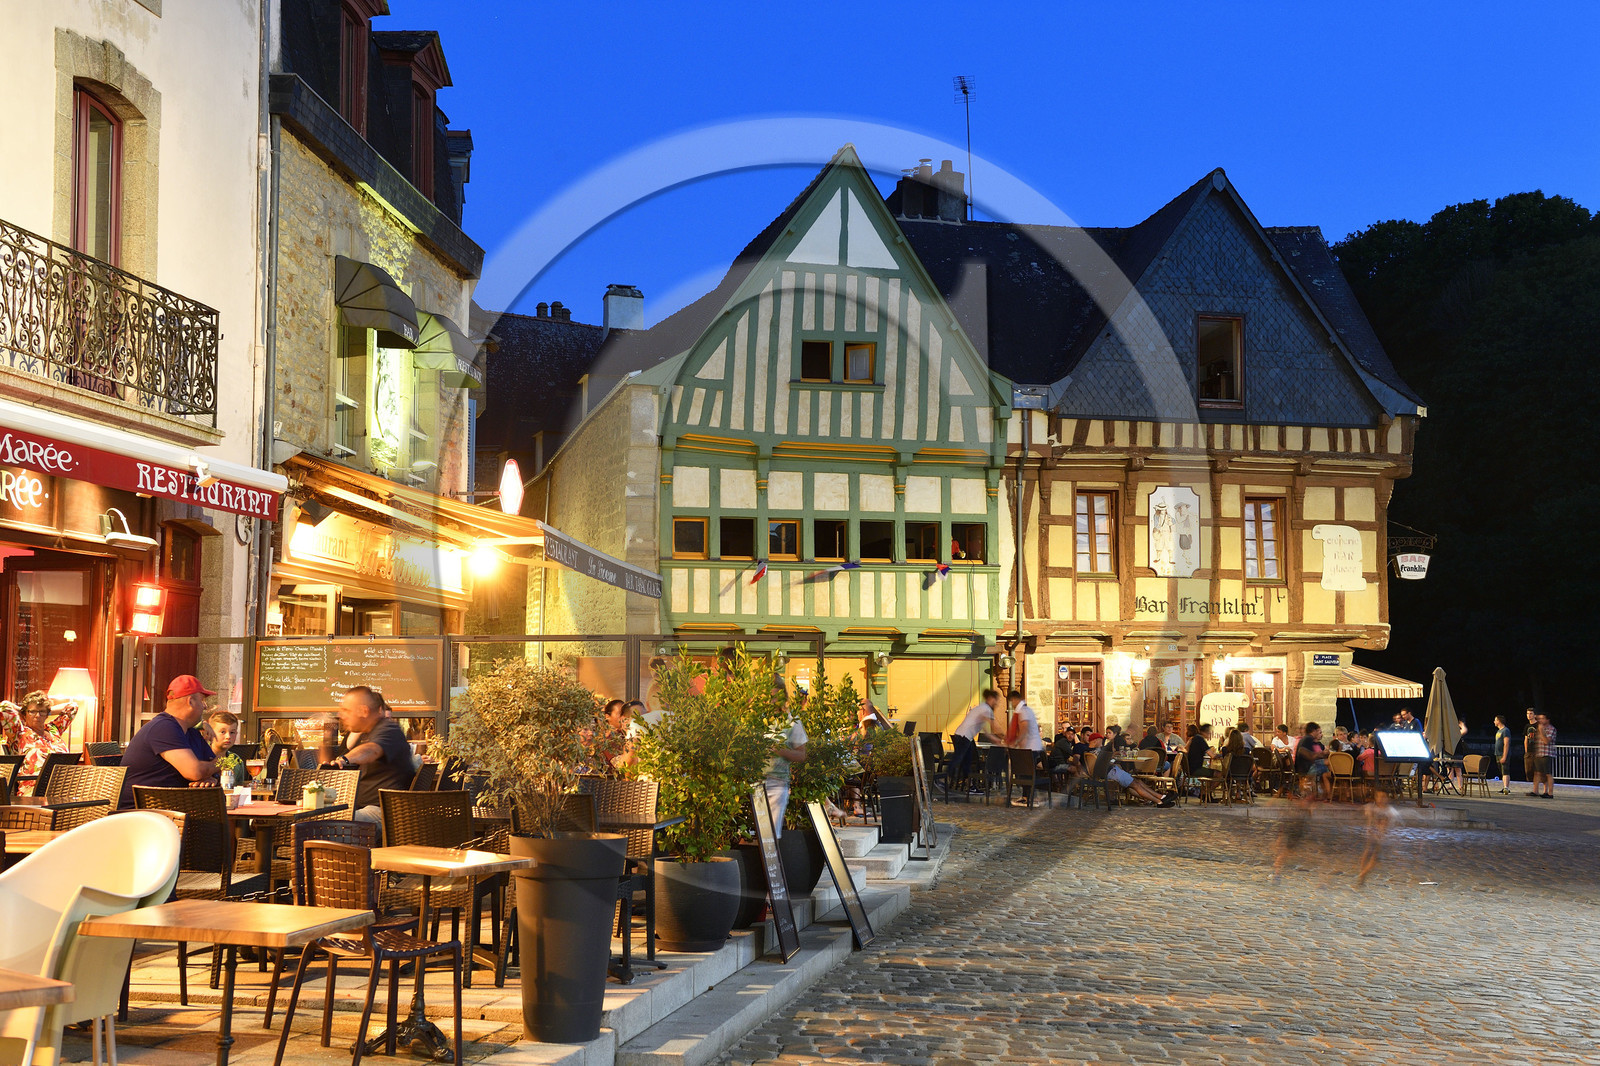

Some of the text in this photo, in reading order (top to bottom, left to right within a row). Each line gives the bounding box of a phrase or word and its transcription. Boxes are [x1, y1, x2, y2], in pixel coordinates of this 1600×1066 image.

[136, 462, 272, 516] RESTAURANT
[545, 535, 578, 569] RESTAURANT
[1401, 555, 1426, 563] BAR
[1135, 596, 1257, 615] Bar Franklin
[1211, 717, 1232, 726] BAR
